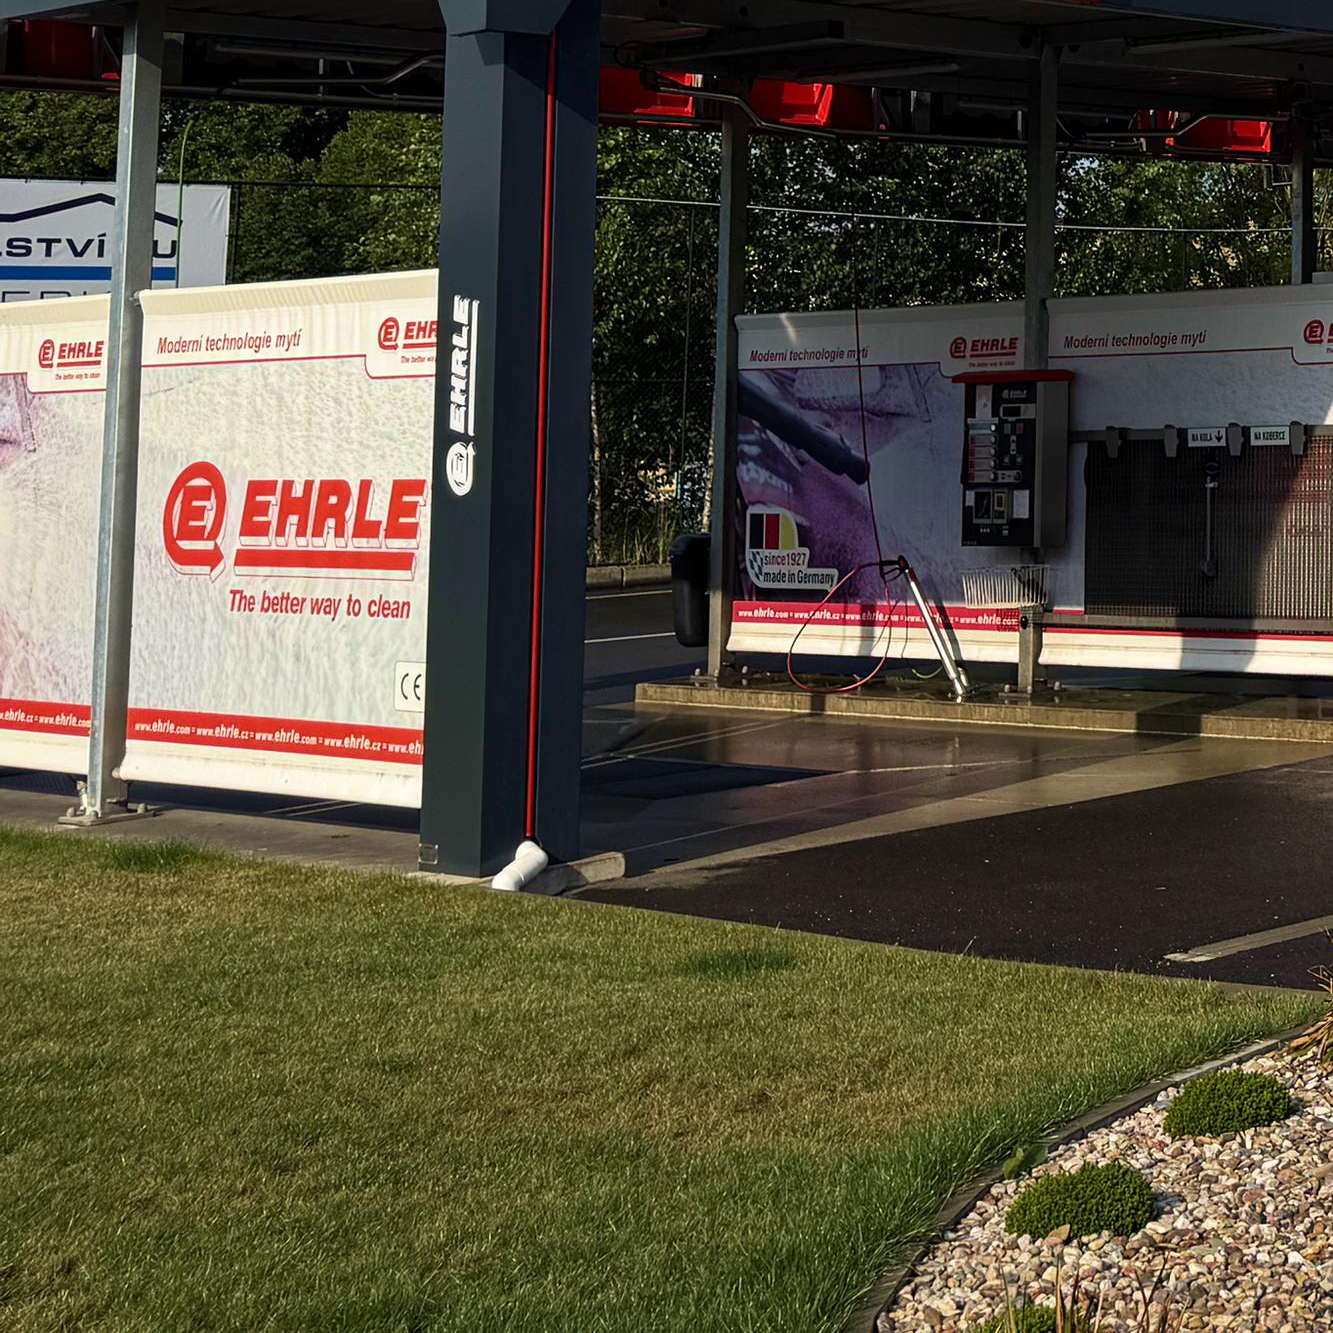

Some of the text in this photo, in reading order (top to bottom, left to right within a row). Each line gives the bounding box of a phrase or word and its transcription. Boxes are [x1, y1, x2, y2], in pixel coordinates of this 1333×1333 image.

[0, 232, 107, 258] STVÍ
[57, 340, 104, 360] EHRLE
[157, 328, 302, 355] Moderní technologie mytí
[970, 337, 1019, 352] EHRLE
[1064, 329, 1208, 349] Moderní technologie mytí
[449, 294, 471, 433] EHRLE
[750, 349, 788, 362] Moderní
[789, 347, 845, 363] technologie
[239, 479, 428, 549] EHRLE
[763, 569, 835, 586] made in Germany
[229, 589, 412, 622] The better way to clean
[134, 718, 191, 736] www.ehrle.com
[196, 723, 249, 740] www.ehrle.cz
[255, 728, 318, 746] www.ehrle.com
[324, 734, 381, 752] www.ehrle.cz
